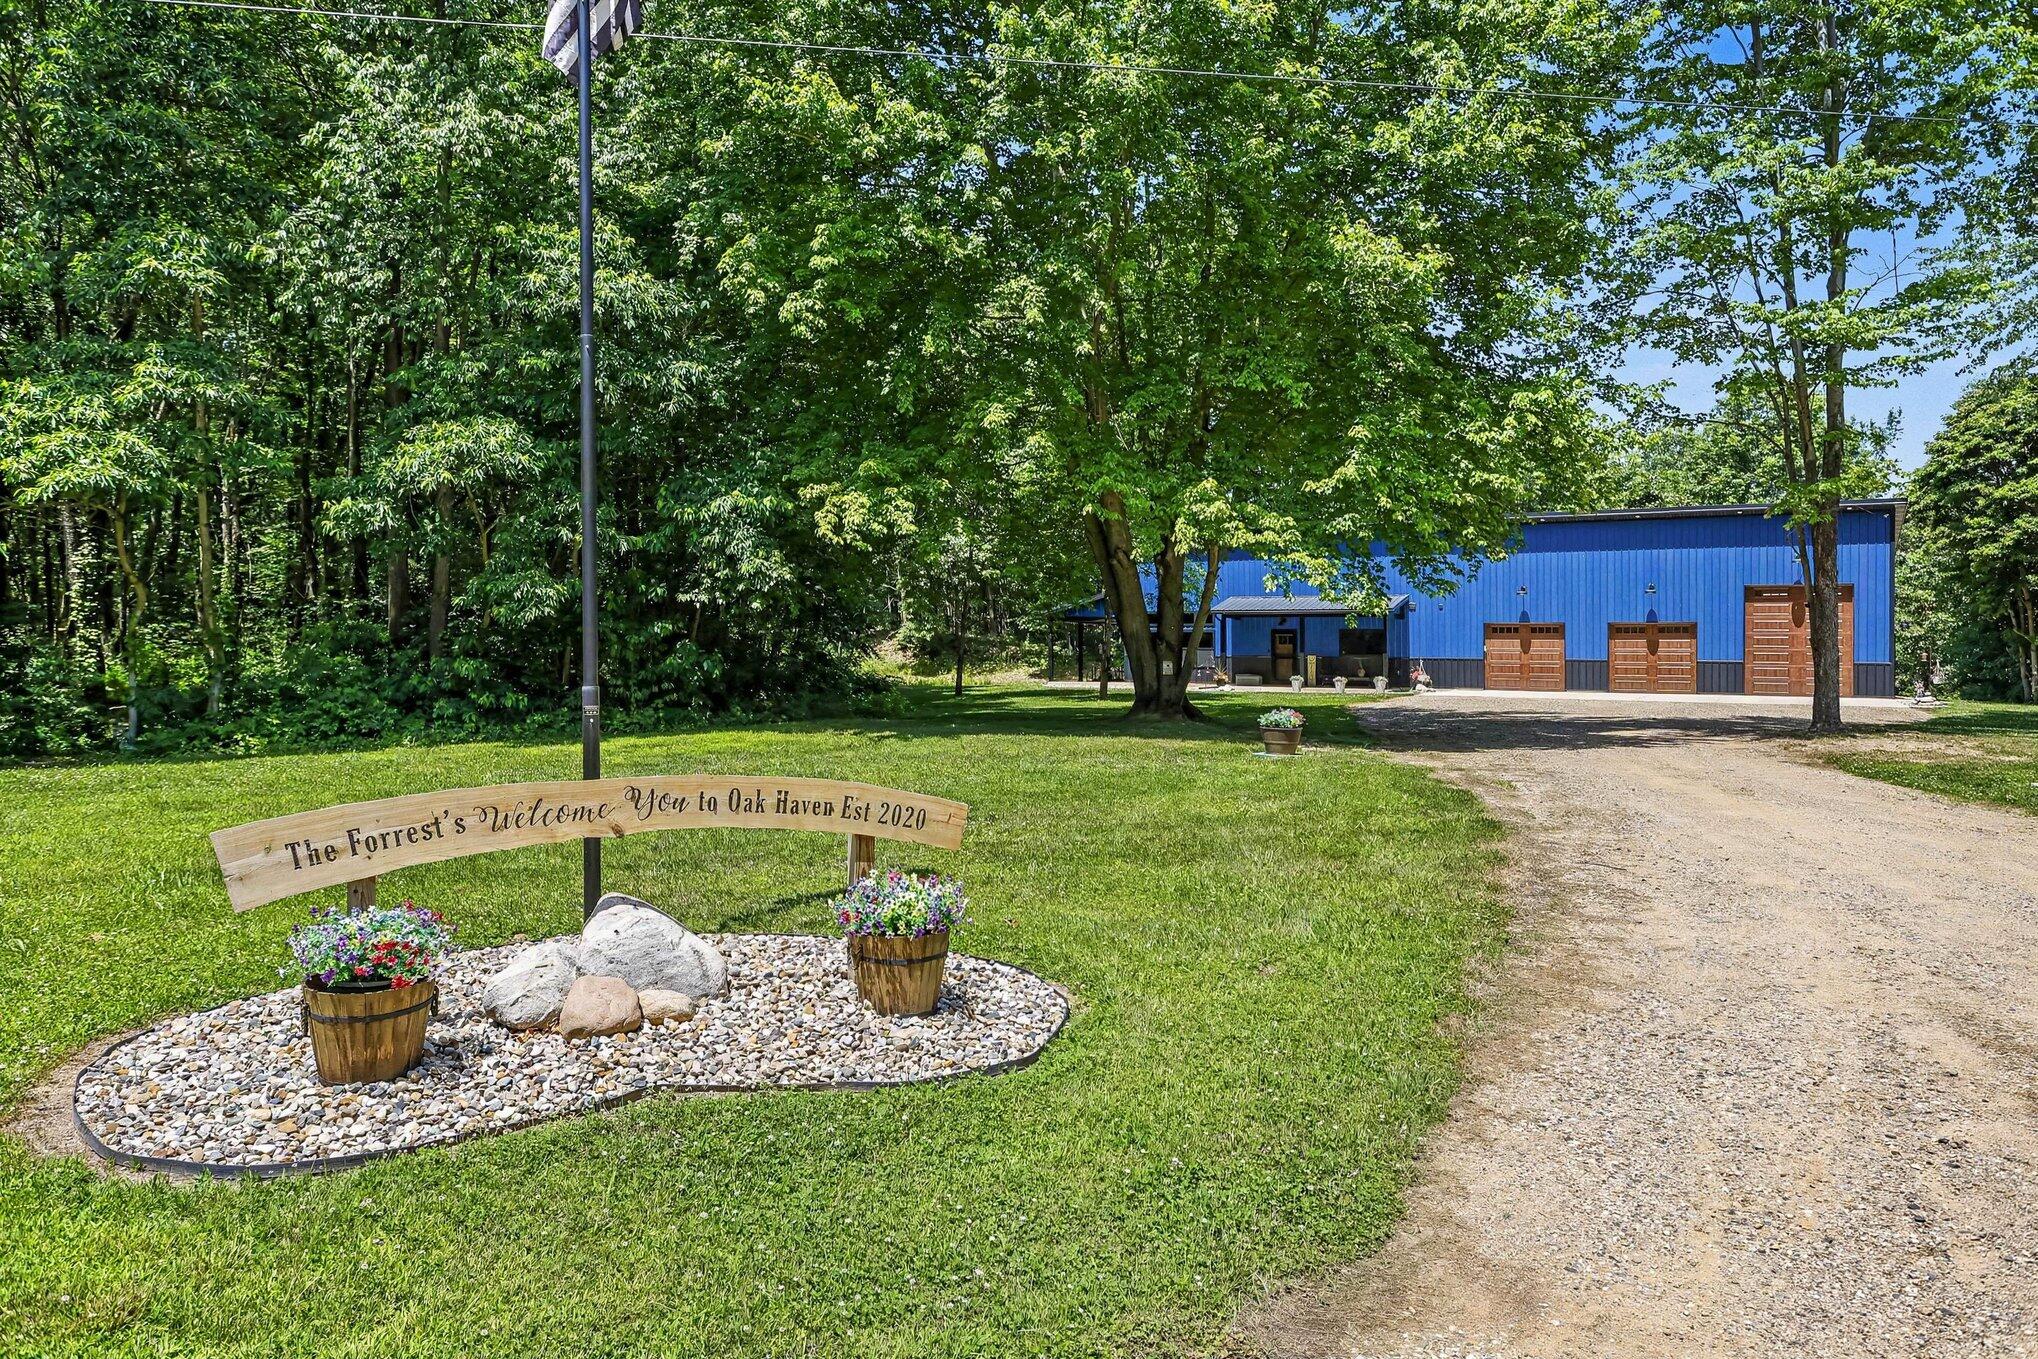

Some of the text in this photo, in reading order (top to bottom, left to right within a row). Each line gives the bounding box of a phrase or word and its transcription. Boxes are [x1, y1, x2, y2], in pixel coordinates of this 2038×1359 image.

[285, 785, 927, 870] The Forrest's Welcome You to Oak Haven Est 2020
